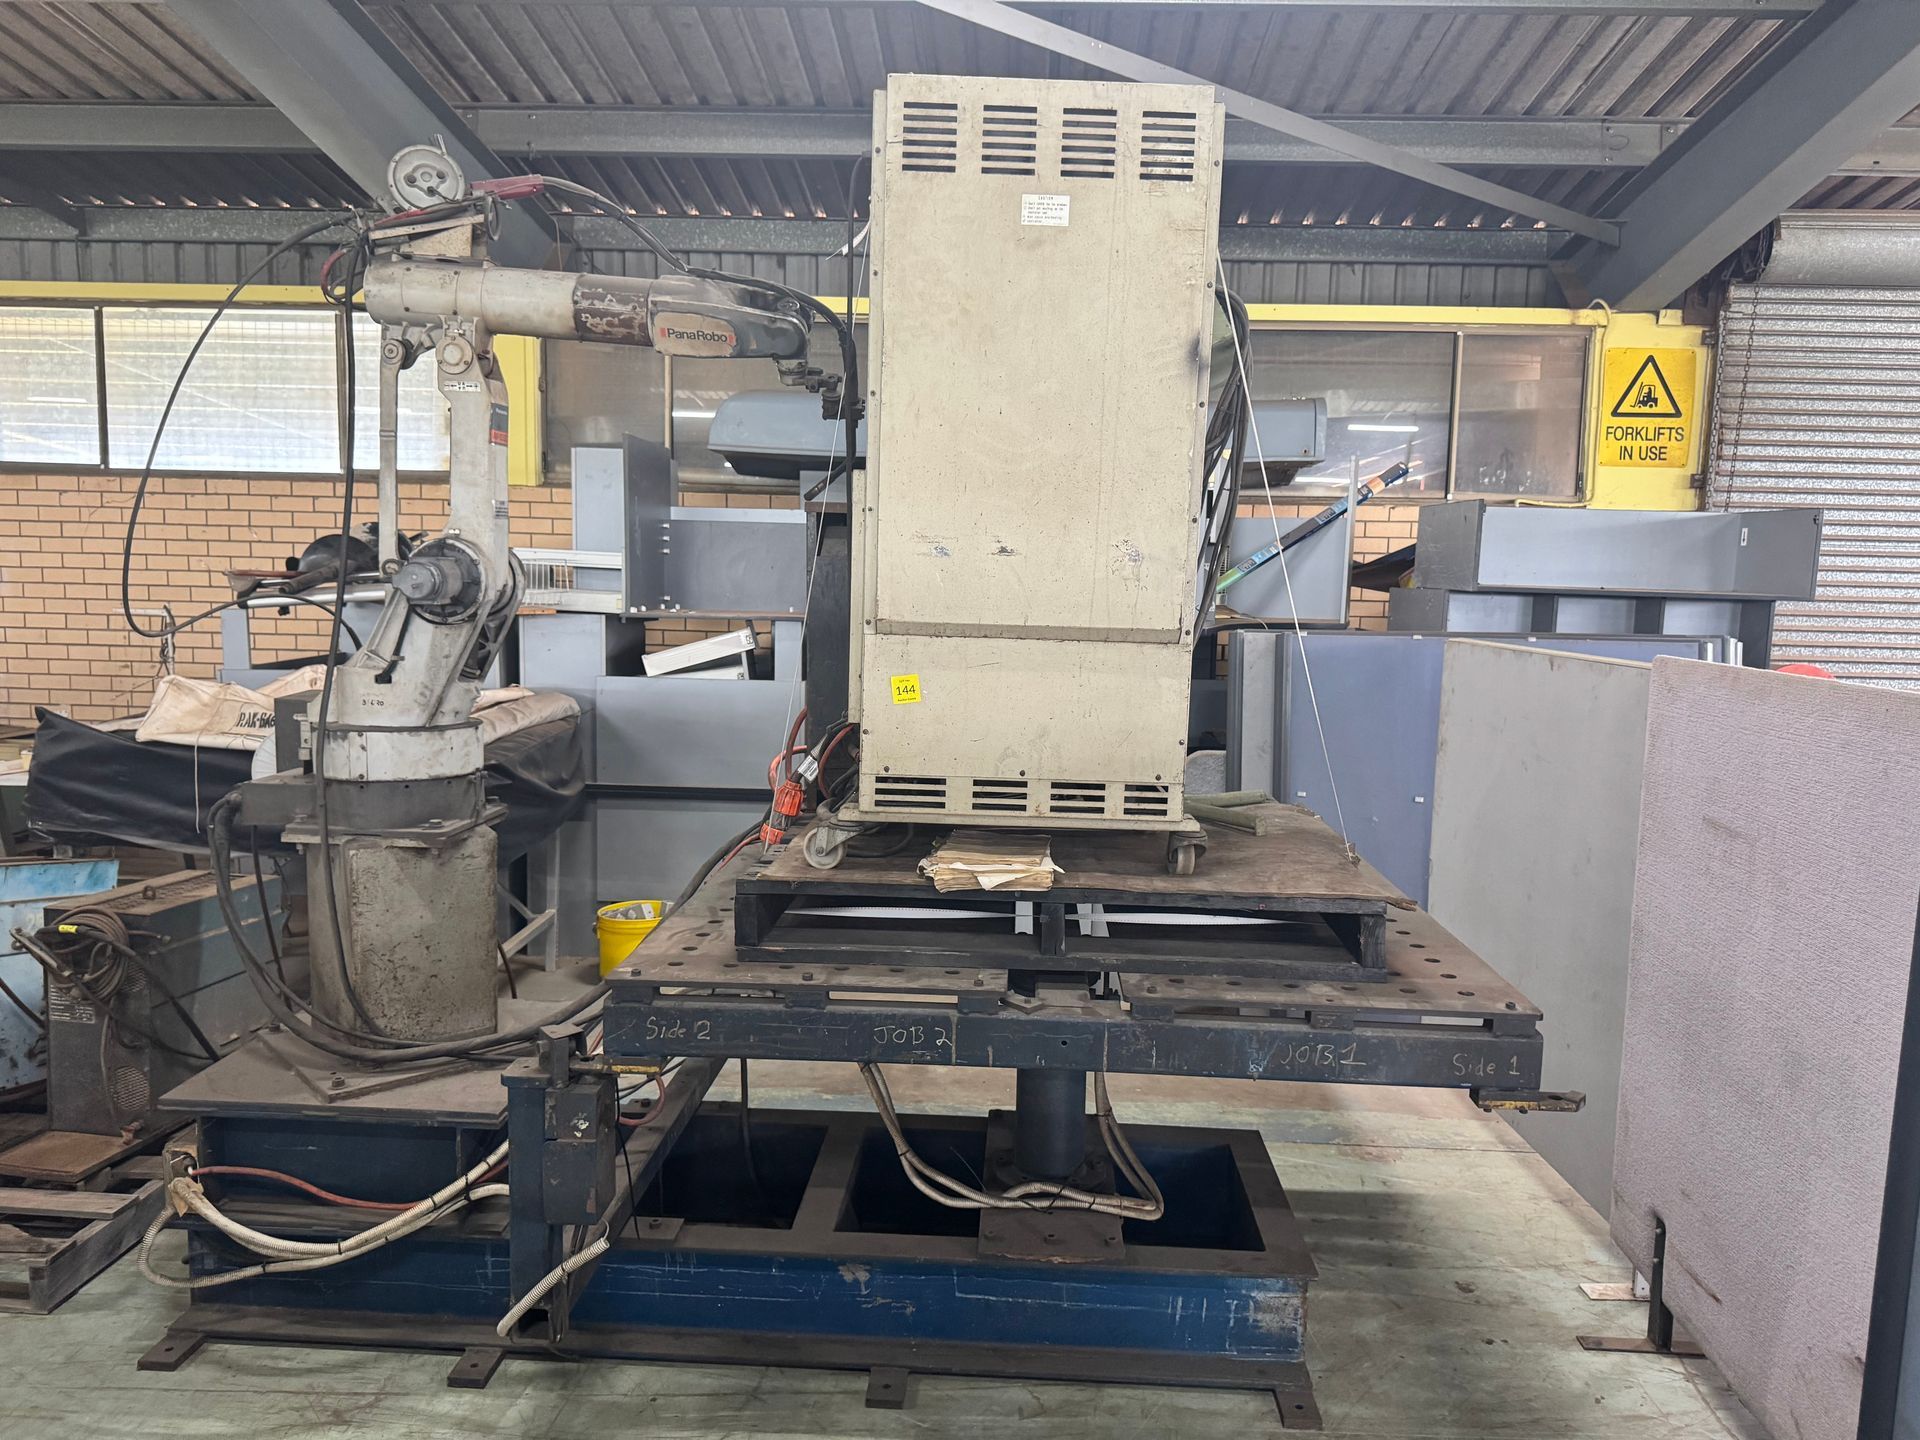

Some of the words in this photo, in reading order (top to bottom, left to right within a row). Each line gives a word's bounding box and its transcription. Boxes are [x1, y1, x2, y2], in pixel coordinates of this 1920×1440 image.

[667, 328, 728, 343] PanaRobo
[1605, 426, 1684, 442] FORKLIFTS
[1619, 446, 1633, 461] IN
[1639, 446, 1667, 461] USE
[896, 685, 916, 696] 144
[646, 1016, 687, 1039] Side
[696, 1020, 710, 1040] 2
[873, 1026, 925, 1045] JOB
[934, 1027, 953, 1046] 2
[1279, 1044, 1335, 1066] JOB
[1339, 1042, 1368, 1066] 1
[1452, 1053, 1496, 1076] Side
[1508, 1055, 1521, 1075] 1
